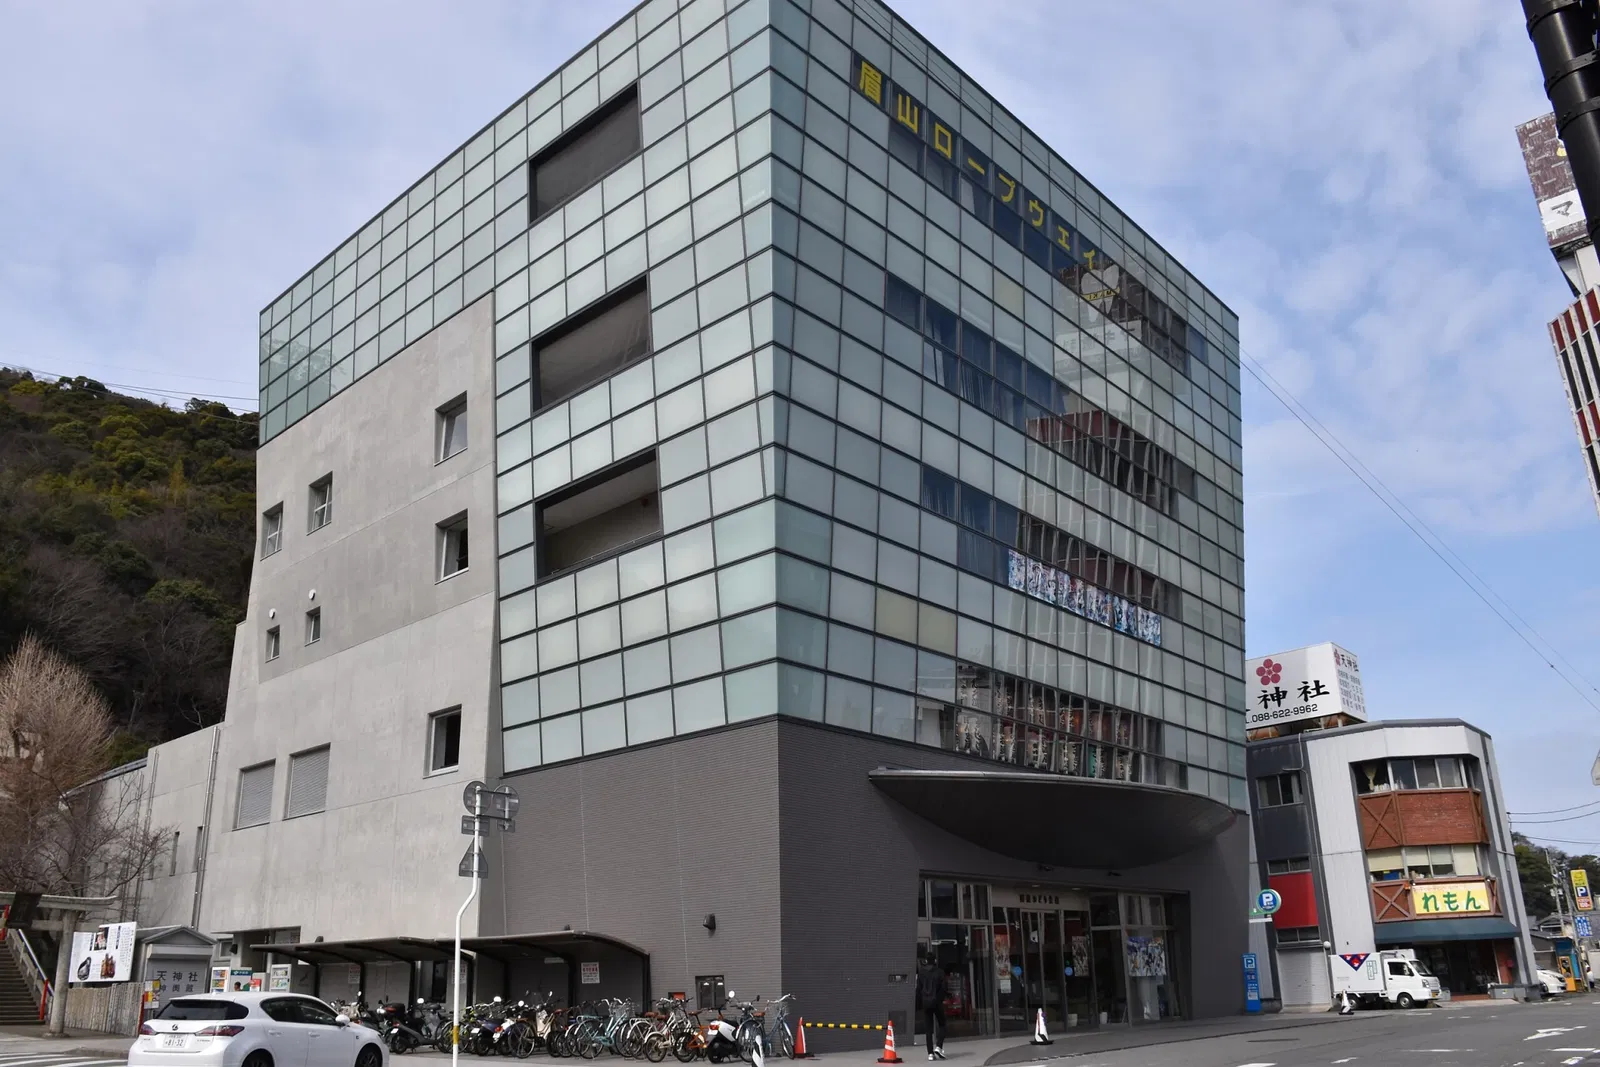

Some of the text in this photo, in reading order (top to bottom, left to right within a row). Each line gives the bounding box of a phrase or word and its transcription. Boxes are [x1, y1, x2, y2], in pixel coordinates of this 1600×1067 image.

[860, 60, 1096, 271] 眉山ロープウェイ
[1245, 680, 1330, 712] 神社
[1262, 893, 1274, 906] P
[1577, 886, 1587, 897] P
[1422, 891, 1481, 912] れもん
[157, 970, 199, 982] 天神社
